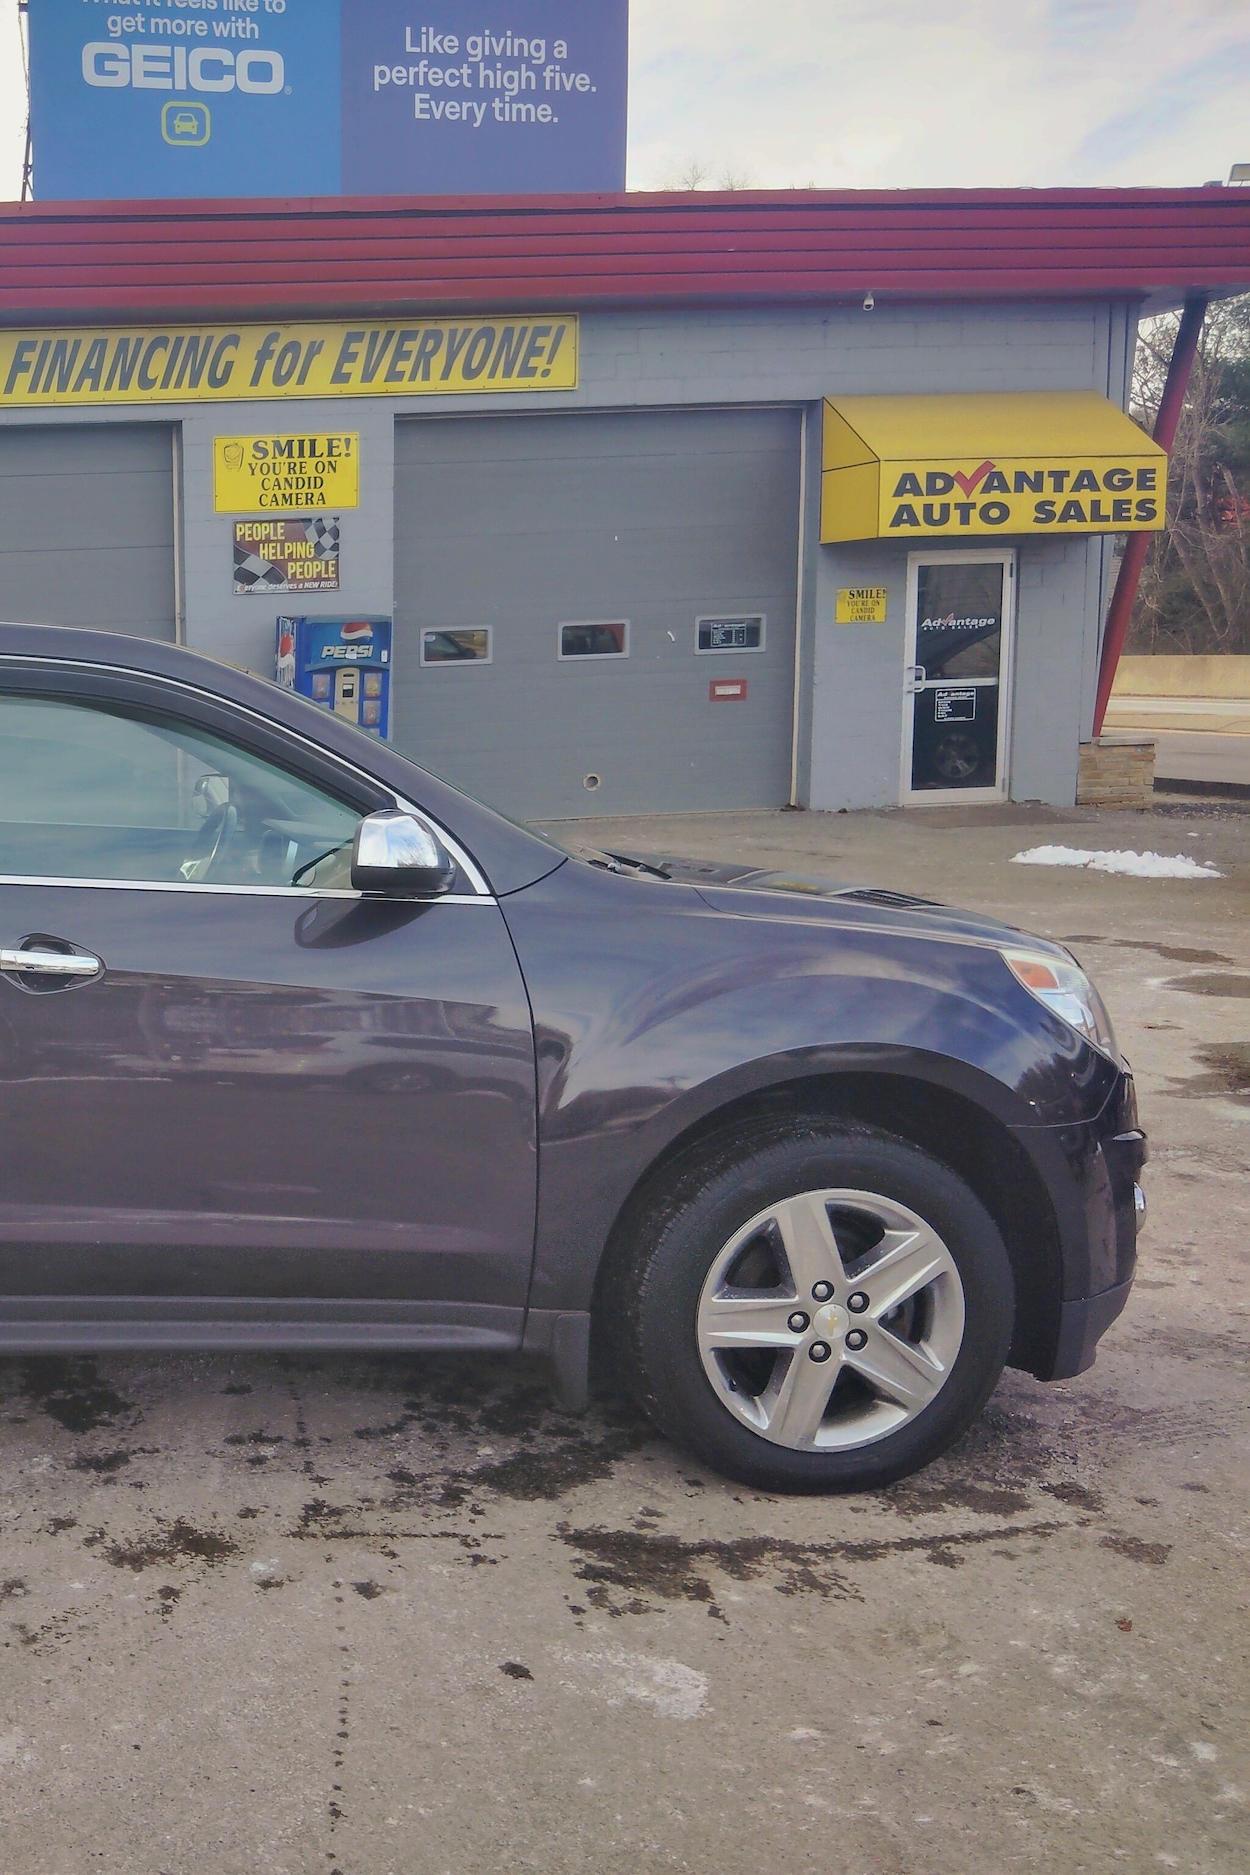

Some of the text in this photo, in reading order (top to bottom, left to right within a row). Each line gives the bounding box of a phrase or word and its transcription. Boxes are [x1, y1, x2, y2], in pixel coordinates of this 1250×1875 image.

[107, 13, 259, 39] get more with
[405, 26, 568, 65] Like giving a
[82, 42, 285, 95] GEICO
[373, 60, 597, 96] perfect high five.
[414, 93, 559, 128] Every time.
[3, 325, 567, 395] FINANCING for EVERYONE!
[251, 437, 352, 460] SMILE!
[247, 460, 338, 476] YOU'RE ON
[261, 476, 324, 491] CANDID
[258, 492, 327, 507] CAMERA
[889, 498, 1158, 527] AUTO SALES
[235, 522, 286, 542] PEOPLE
[259, 541, 316, 560] HELPING
[287, 560, 336, 580] PEOPLE
[303, 581, 321, 589] NEW
[848, 588, 886, 599] SMILE!
